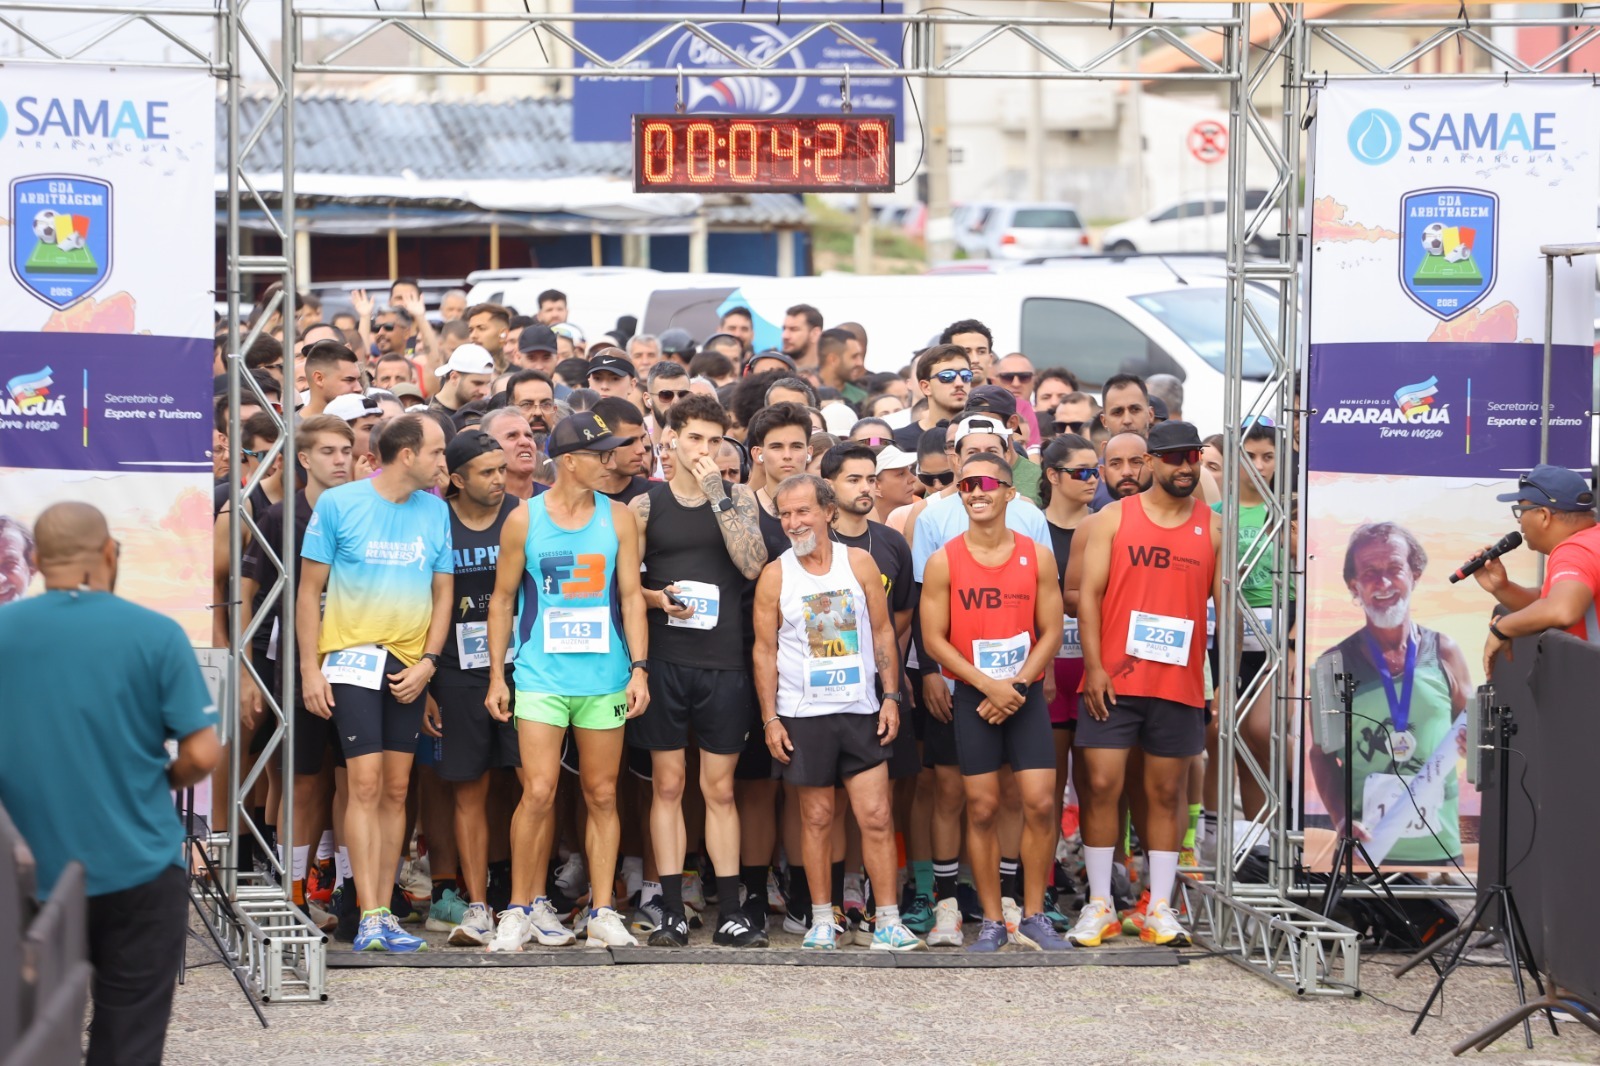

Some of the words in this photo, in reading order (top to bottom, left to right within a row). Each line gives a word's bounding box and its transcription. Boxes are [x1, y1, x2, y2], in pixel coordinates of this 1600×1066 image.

[16, 96, 170, 139] SAMAE
[1408, 112, 1556, 152] SAMAE
[644, 123, 885, 183] 00:04:27
[49, 182, 74, 194] GDA
[20, 193, 103, 206] ARBITRAGEM
[1438, 196, 1462, 206] GDA
[1410, 207, 1489, 217] ARBITRAGEM
[50, 287, 73, 297] 2025
[1437, 299, 1458, 307] 2025
[104, 393, 158, 404] Secretaria
[160, 394, 175, 404] de
[1487, 402, 1539, 411] Secretaria
[104, 408, 146, 420] Esporte
[149, 411, 156, 419] e
[159, 409, 202, 420] Turismo
[1320, 404, 1450, 424] ARARANGUÁ
[1487, 417, 1527, 428] Esporte
[1379, 427, 1409, 439] Terra
[1411, 428, 1443, 439] nossa
[365, 550, 414, 560] RUNNERS
[538, 550, 573, 558] ASSESSORIA
[1128, 545, 1171, 569] WB
[1172, 556, 1200, 566] RUNNERS
[540, 553, 606, 595] F3
[958, 588, 1002, 610] WB
[561, 623, 591, 637] 143
[1145, 627, 1175, 644] 226
[823, 638, 846, 657] 70
[1146, 643, 1168, 651] PAULO
[336, 652, 367, 668] 274
[991, 650, 1018, 667] 212
[826, 670, 846, 685] 70
